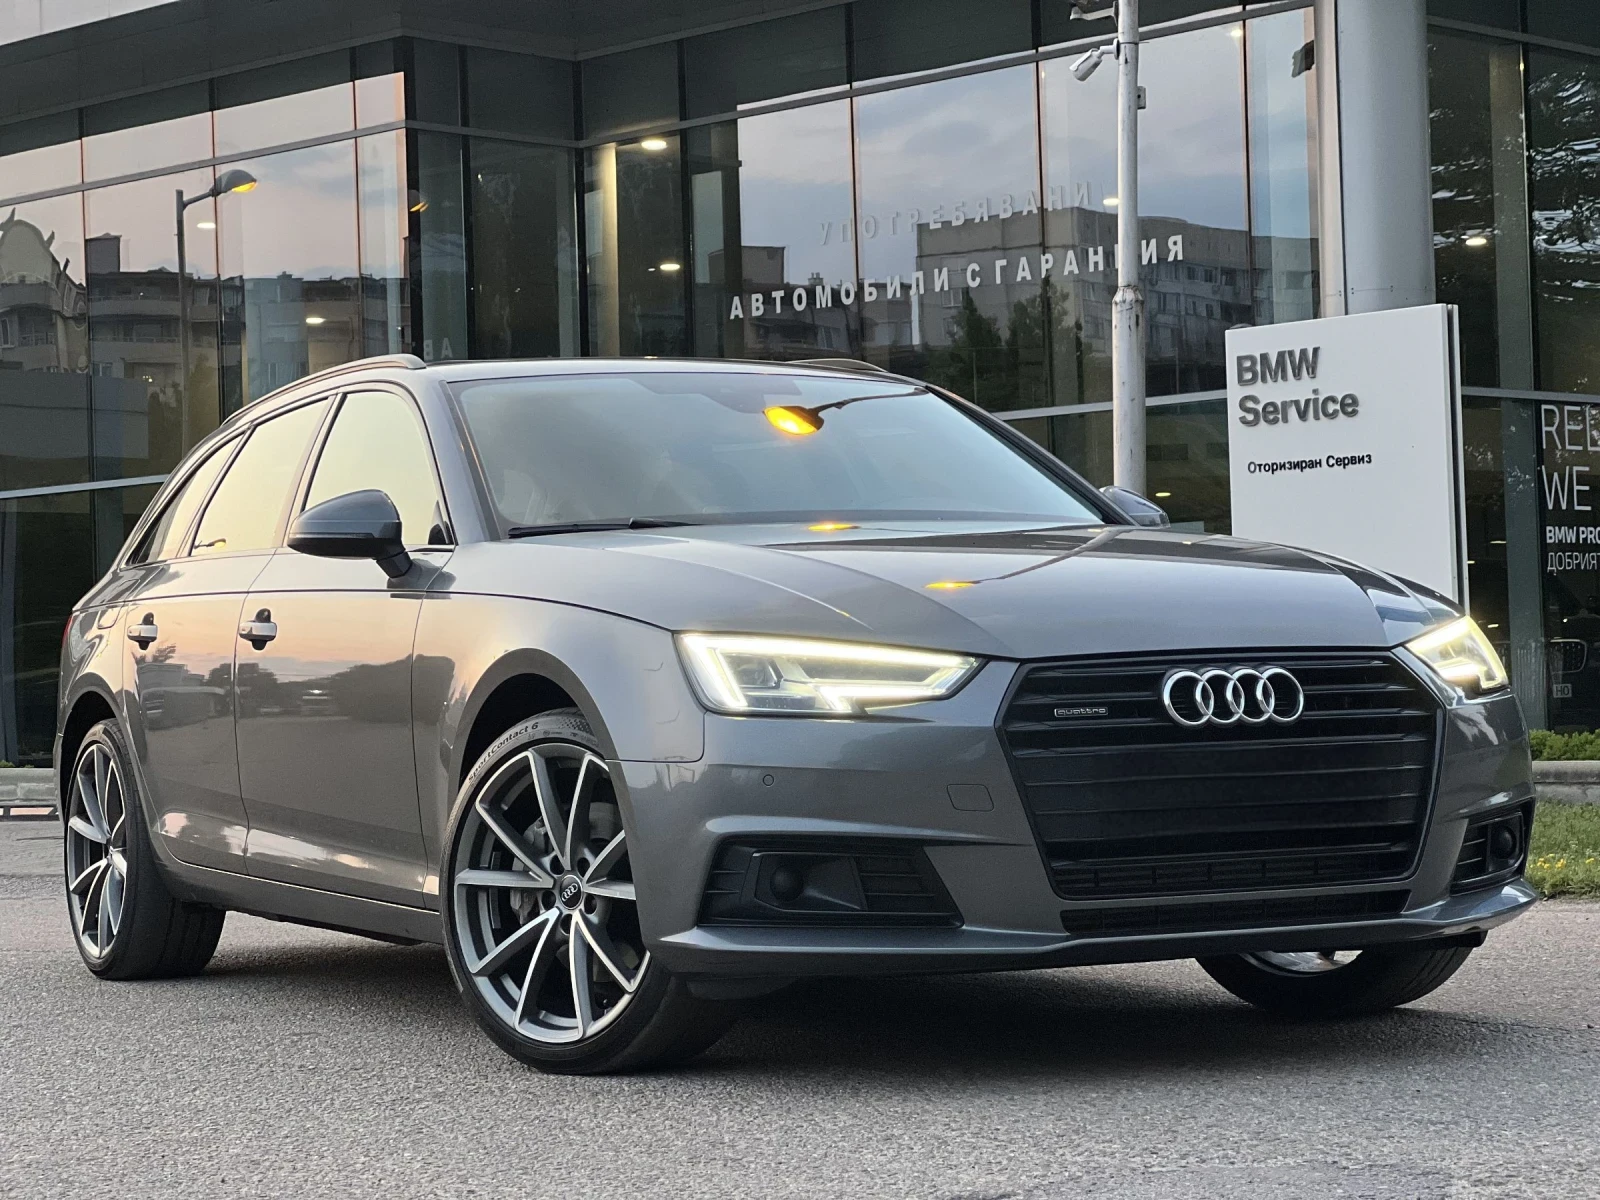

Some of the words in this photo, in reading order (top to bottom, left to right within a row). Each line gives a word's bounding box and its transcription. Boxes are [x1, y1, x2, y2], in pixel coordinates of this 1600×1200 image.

[819, 181, 1092, 246] УПОТРЕБЯВАНИ
[729, 266, 949, 320] АВТОМОБИЛИ
[966, 262, 982, 288] С
[994, 234, 1185, 285] ГАРАНИЯ
[1236, 346, 1321, 386] BMW
[1238, 388, 1360, 427] Service
[1247, 458, 1323, 475] Оторизиран
[1325, 453, 1373, 470] Сервиз
[1541, 465, 1593, 511] WE
[1545, 525, 1577, 544] BMW
[531, 721, 539, 730] 6
[1057, 707, 1107, 716] quattro
